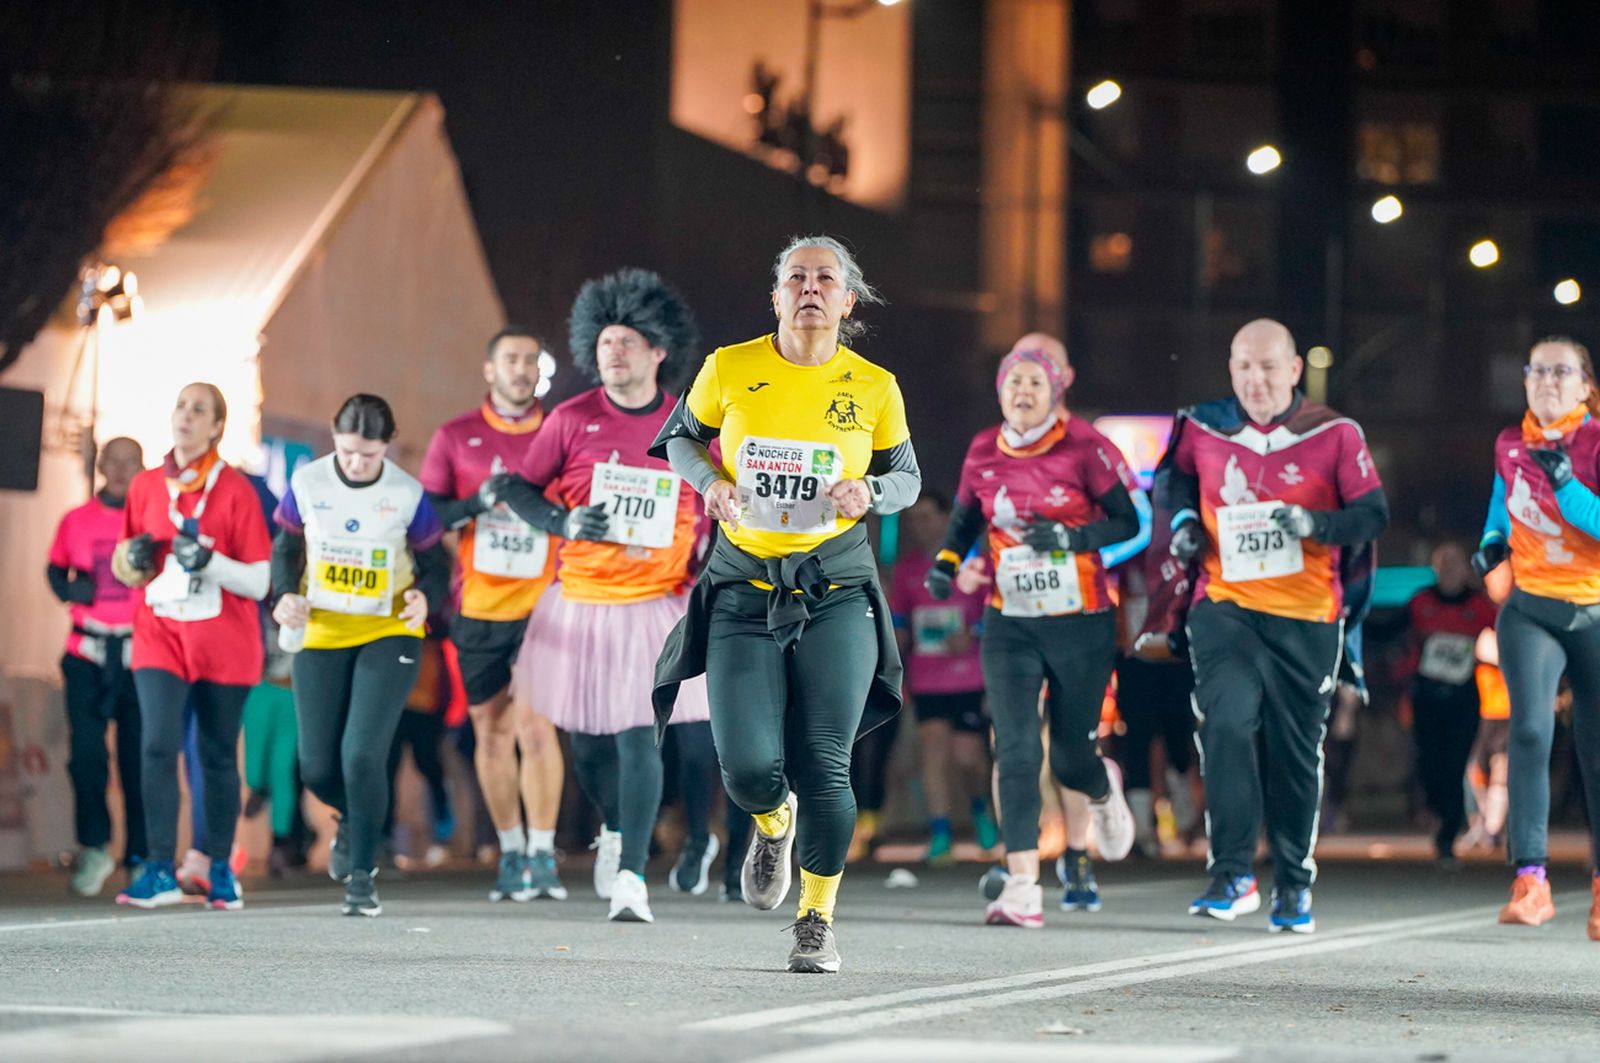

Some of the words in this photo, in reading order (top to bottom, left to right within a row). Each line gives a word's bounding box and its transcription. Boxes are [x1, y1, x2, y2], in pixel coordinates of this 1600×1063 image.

[746, 458, 766, 470] SAN
[757, 449, 788, 460] NOCHE
[791, 451, 803, 461] DE
[756, 472, 818, 501] 3479
[613, 493, 656, 519] 7170
[1236, 530, 1284, 553] 2573
[325, 565, 377, 589] 4400
[1014, 570, 1060, 592] 1368
